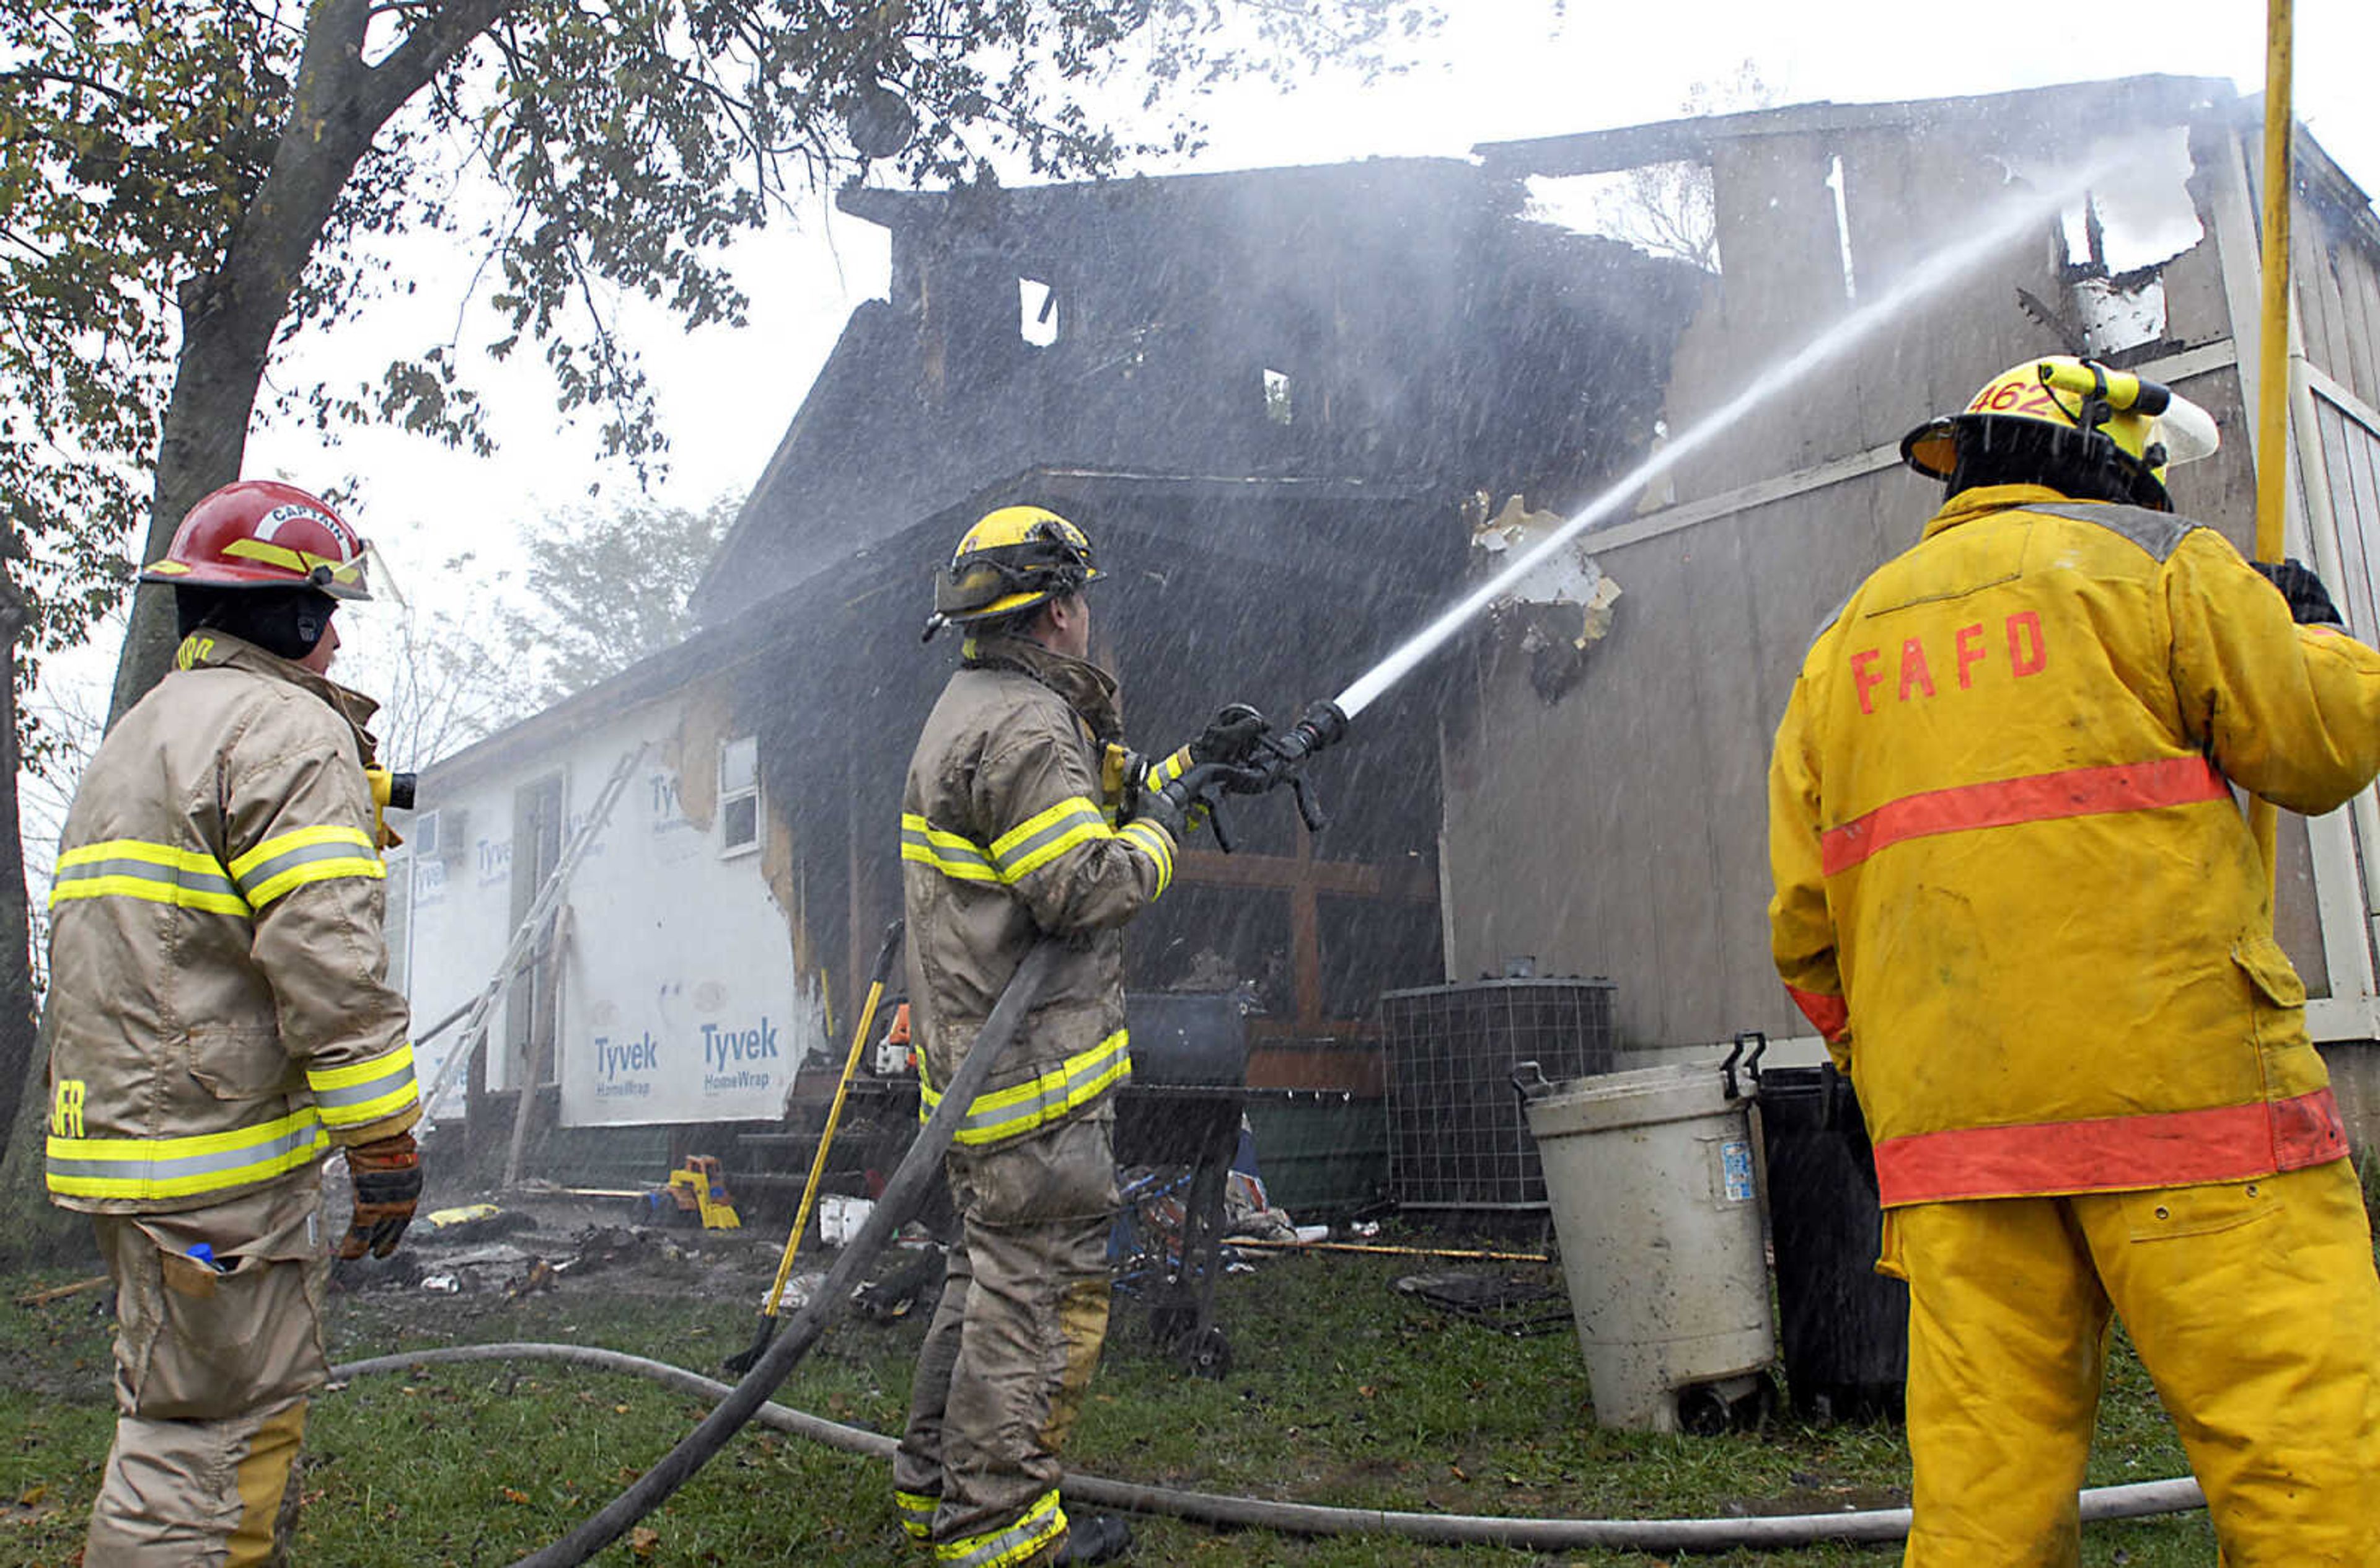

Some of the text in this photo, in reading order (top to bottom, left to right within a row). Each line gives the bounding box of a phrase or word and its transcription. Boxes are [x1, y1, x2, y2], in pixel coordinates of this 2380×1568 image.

[1969, 382, 2052, 416] 462
[273, 506, 344, 541] CAPTAIN
[1850, 610, 2047, 715] FAFD
[594, 1030, 657, 1081] Tyvek
[700, 1016, 778, 1073] Tyvek
[705, 1070, 769, 1090] HomeWrap
